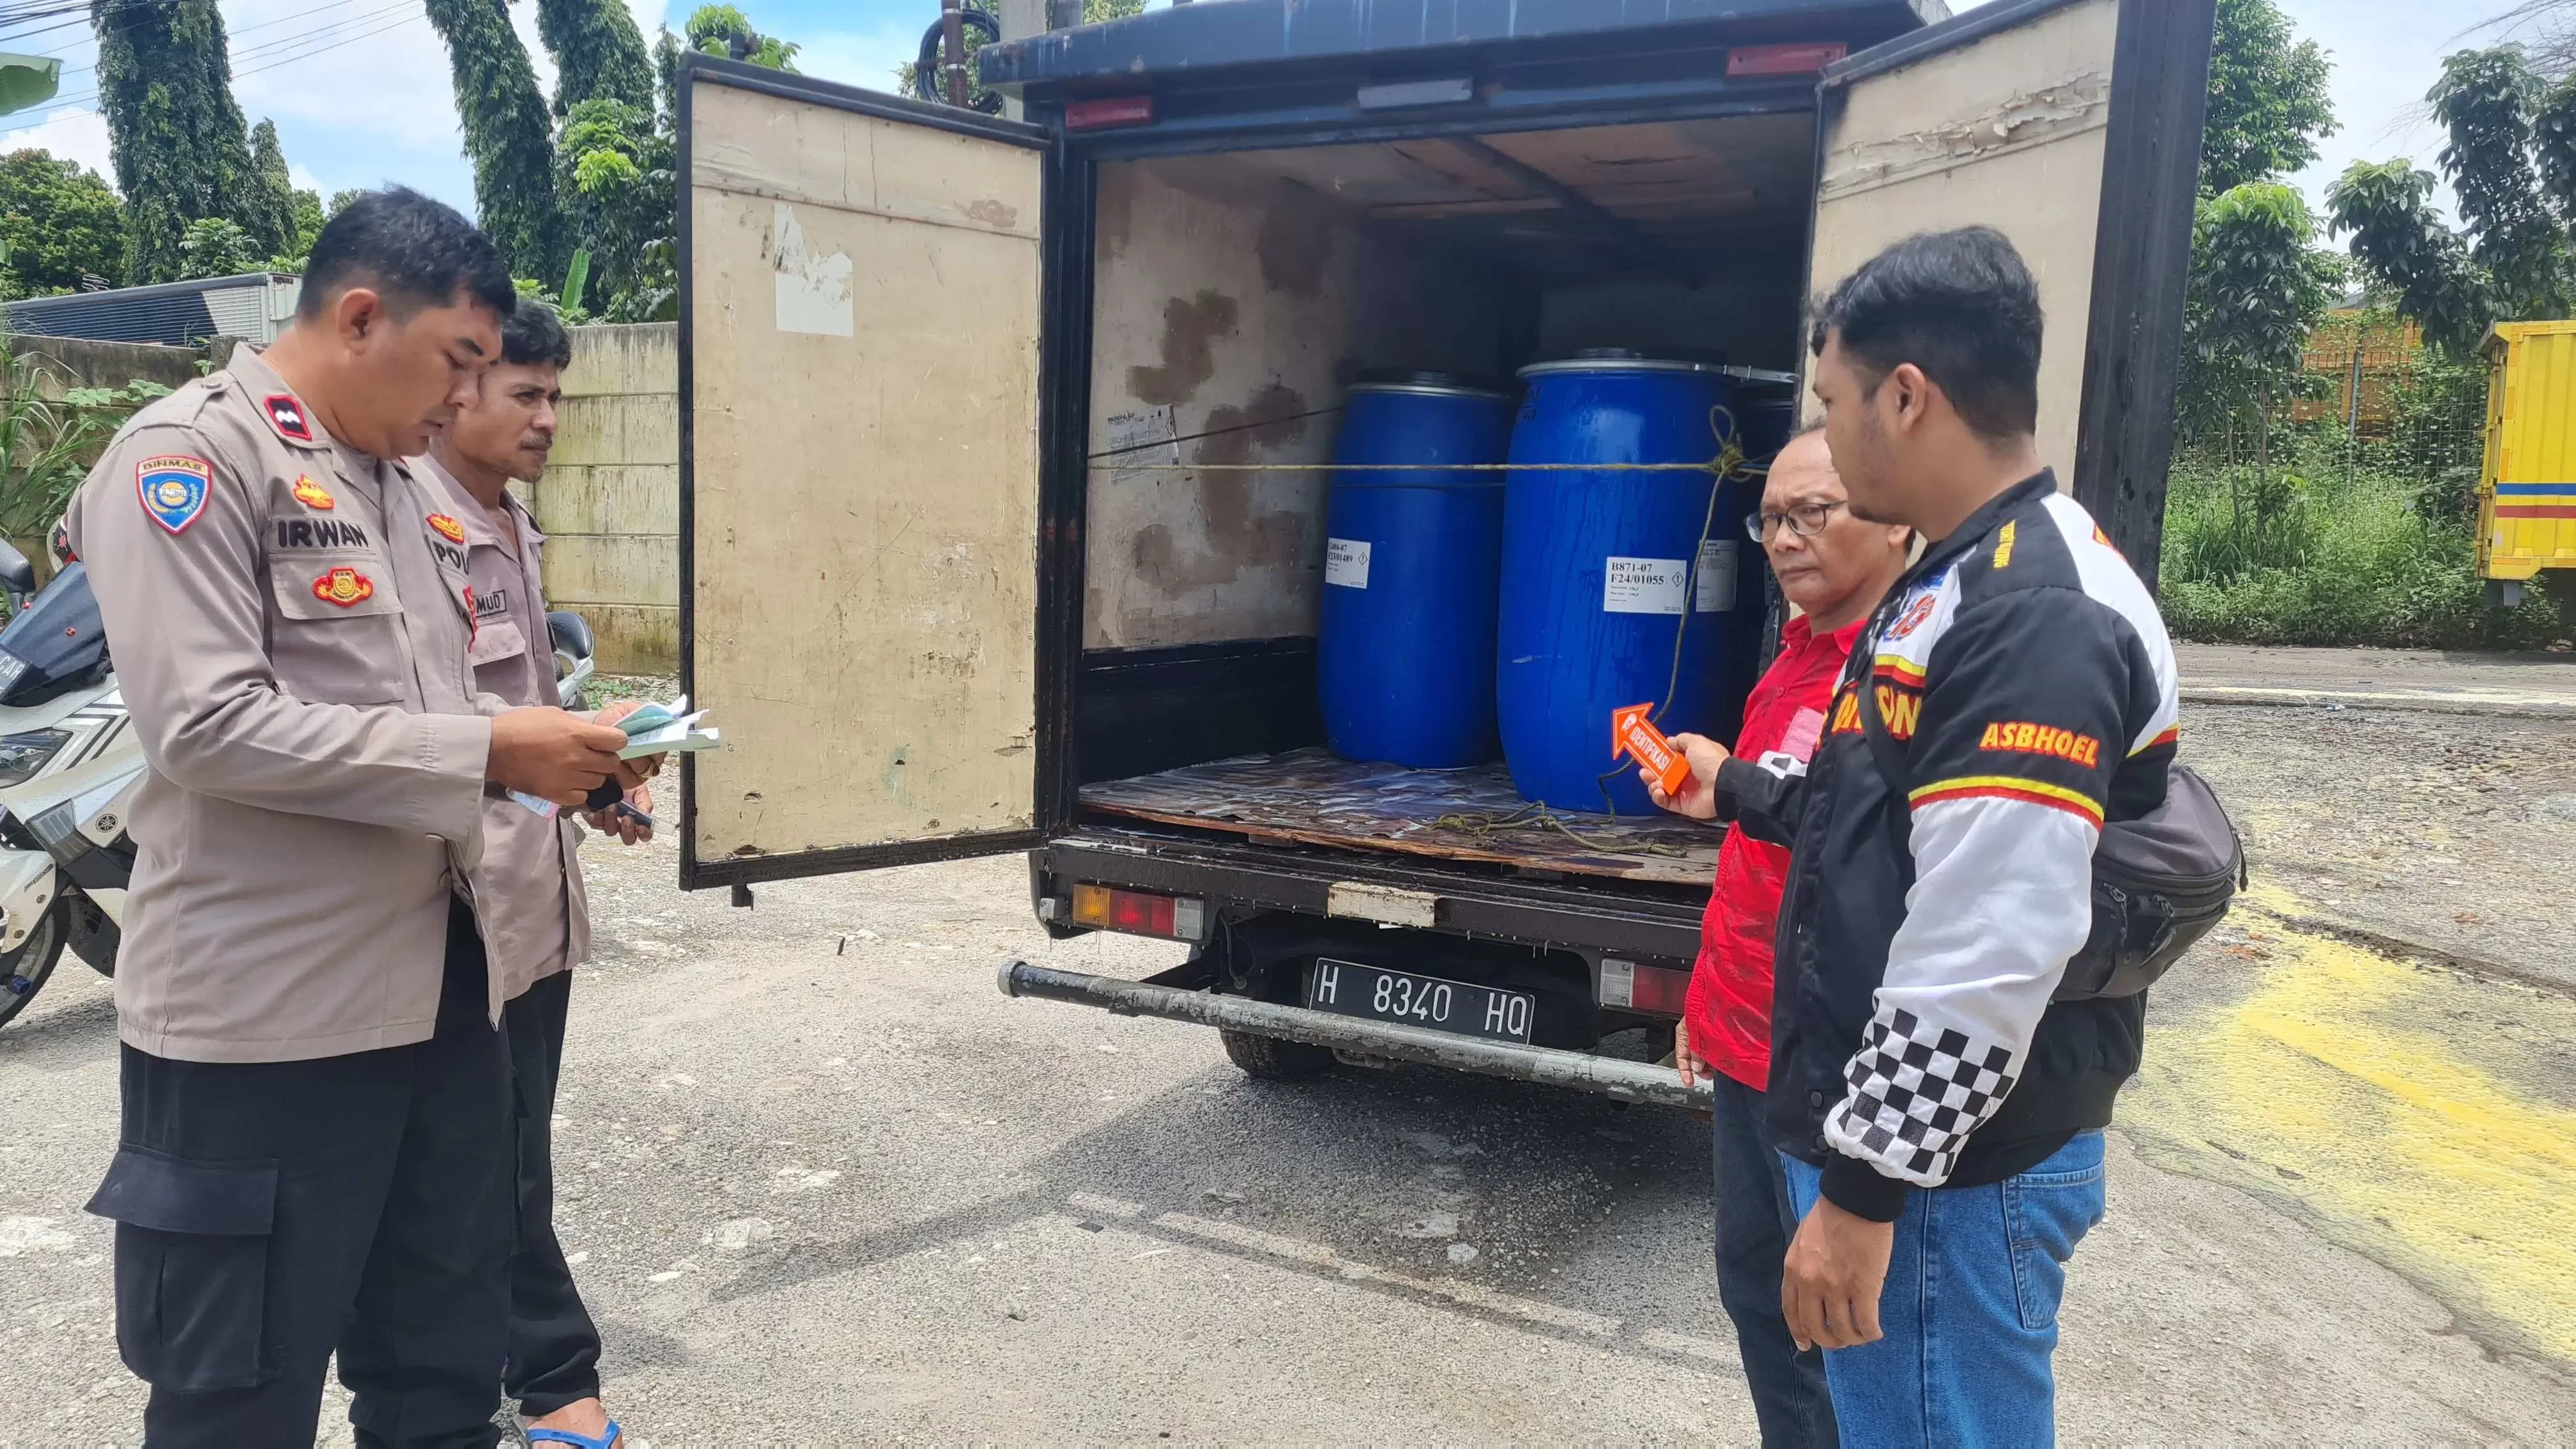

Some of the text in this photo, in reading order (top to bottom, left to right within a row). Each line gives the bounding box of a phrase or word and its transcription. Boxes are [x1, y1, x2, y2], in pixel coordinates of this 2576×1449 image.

[143, 459, 202, 471] BINMAS
[277, 520, 369, 548] IRWAN
[1611, 562, 1653, 573] B871-07
[1611, 573, 1664, 585] F24/01055
[1629, 725, 1672, 772] IDENTIFIKASI
[1980, 721, 2099, 769] ASBHOEL
[1318, 964, 1528, 1036] H 8340 HQ
